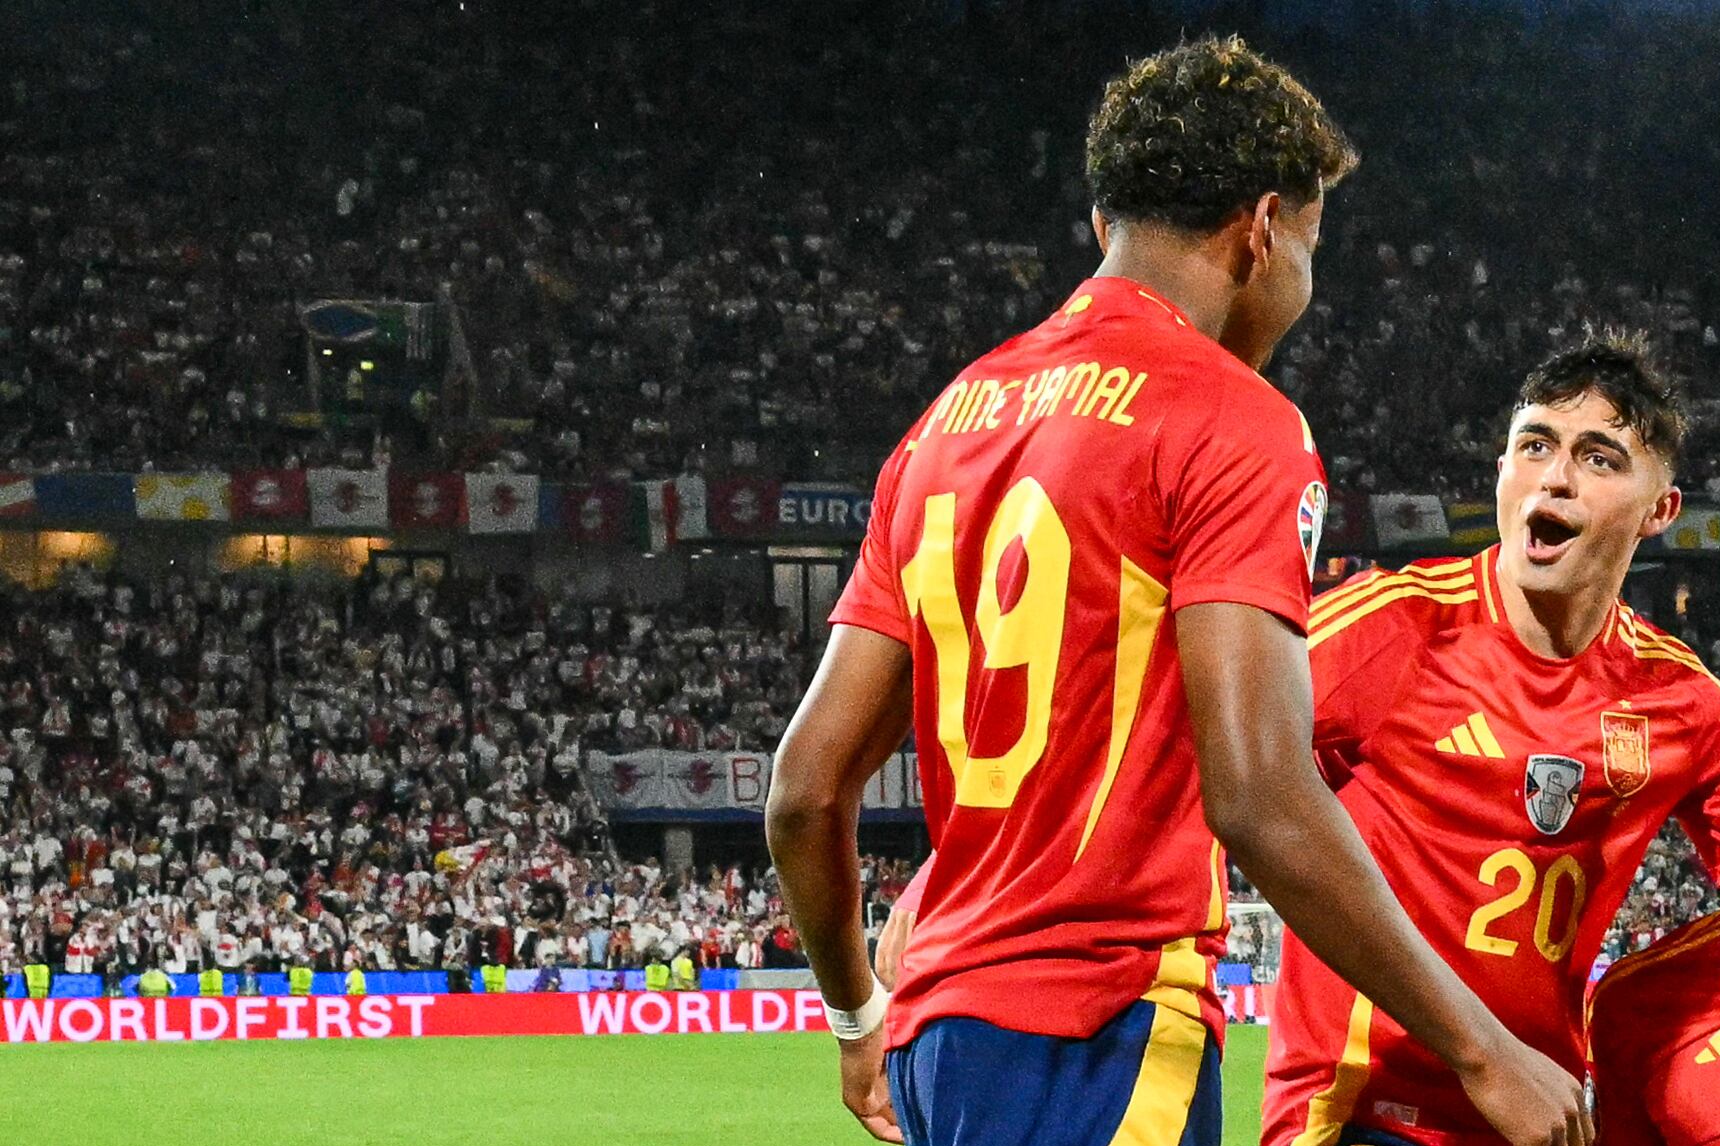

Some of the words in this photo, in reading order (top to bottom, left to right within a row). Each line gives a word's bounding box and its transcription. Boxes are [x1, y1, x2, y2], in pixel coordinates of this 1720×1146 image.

[904, 379, 1023, 452] MINE
[1016, 361, 1148, 427] YAMAL
[900, 475, 1072, 809] 19
[1464, 847, 1586, 962] 20
[4, 996, 436, 1042] WORLDFIRST
[578, 990, 824, 1035] WORLDF
